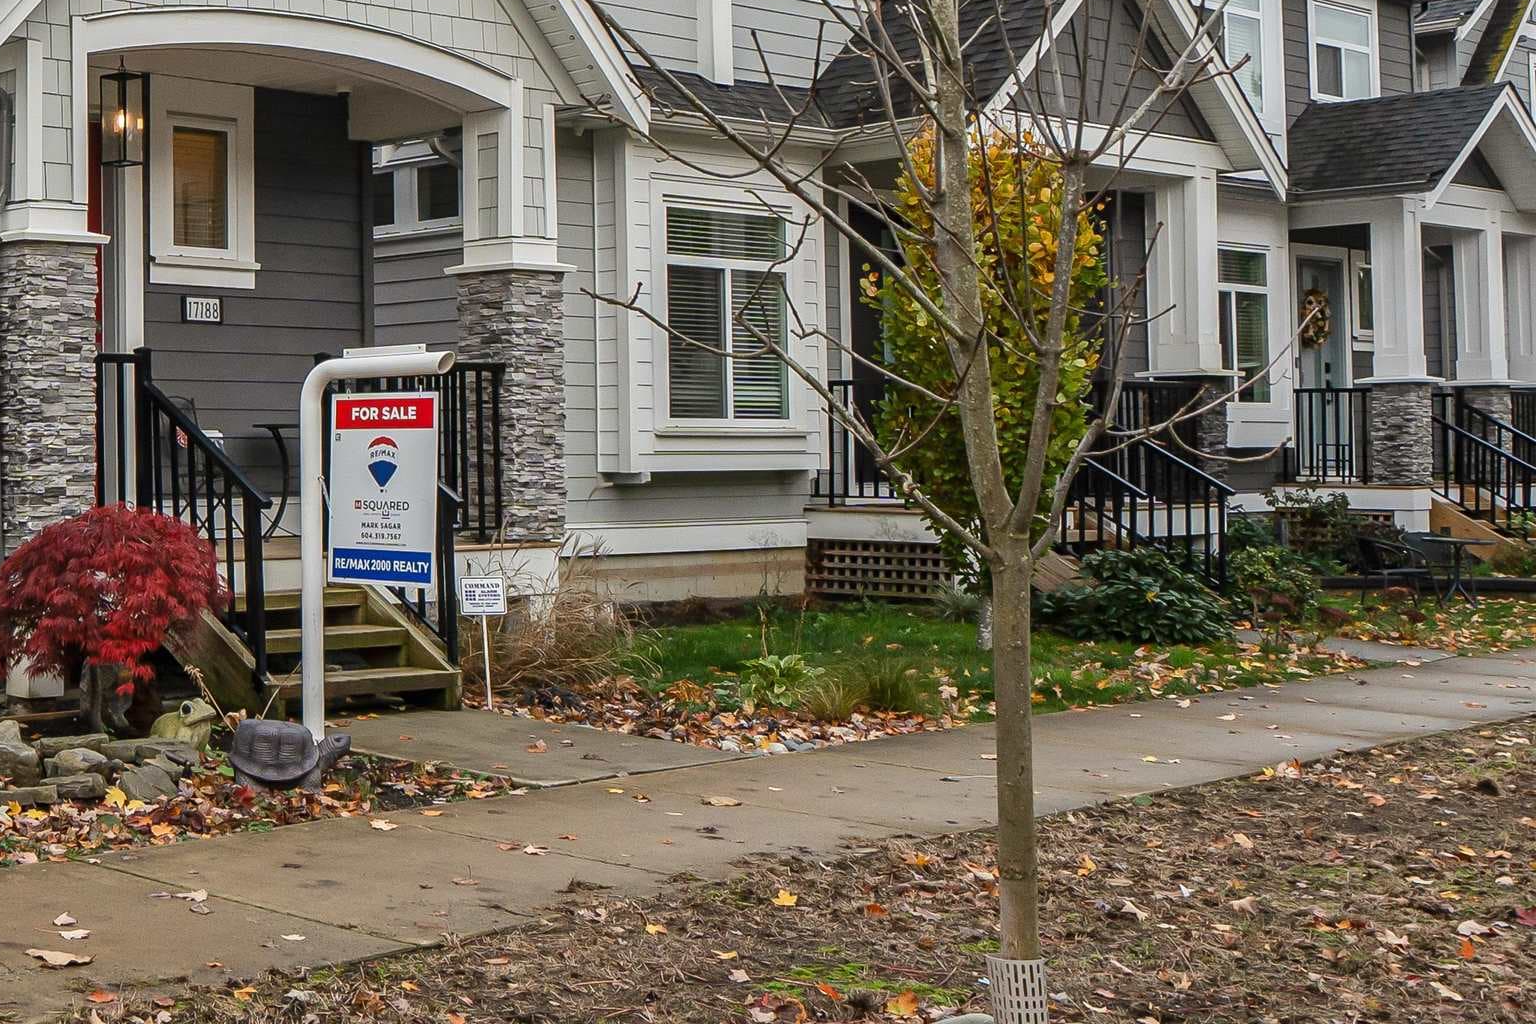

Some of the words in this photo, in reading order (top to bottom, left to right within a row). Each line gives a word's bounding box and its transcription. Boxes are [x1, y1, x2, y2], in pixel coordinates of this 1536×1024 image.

[188, 301, 219, 319] 17188
[351, 407, 379, 421] FOR
[381, 406, 417, 420] SALE
[369, 449, 396, 459] RE/MAX
[335, 557, 370, 571] RE/MAX
[370, 559, 391, 571] 2000
[393, 560, 429, 574] REALTY
